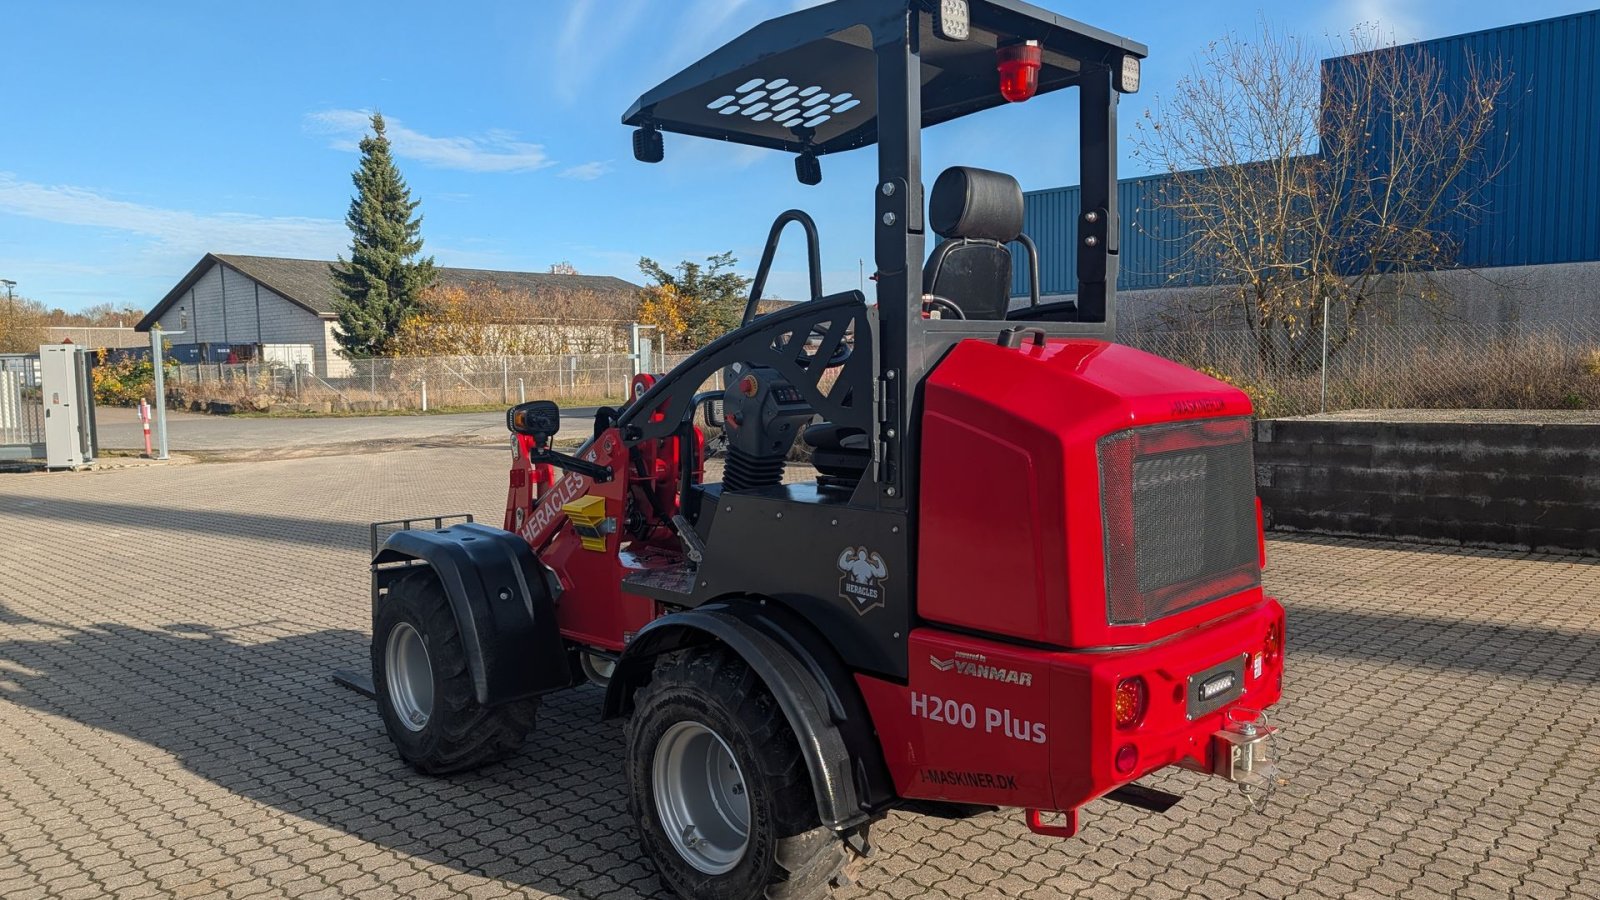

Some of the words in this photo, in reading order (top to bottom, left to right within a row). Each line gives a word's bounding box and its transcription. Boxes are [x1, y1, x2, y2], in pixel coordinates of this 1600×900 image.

[521, 472, 584, 543] HERACLES
[846, 583, 878, 599] HERACLES
[954, 661, 1033, 687] YANMAR
[911, 691, 977, 729] H200
[985, 707, 1047, 744] Plus
